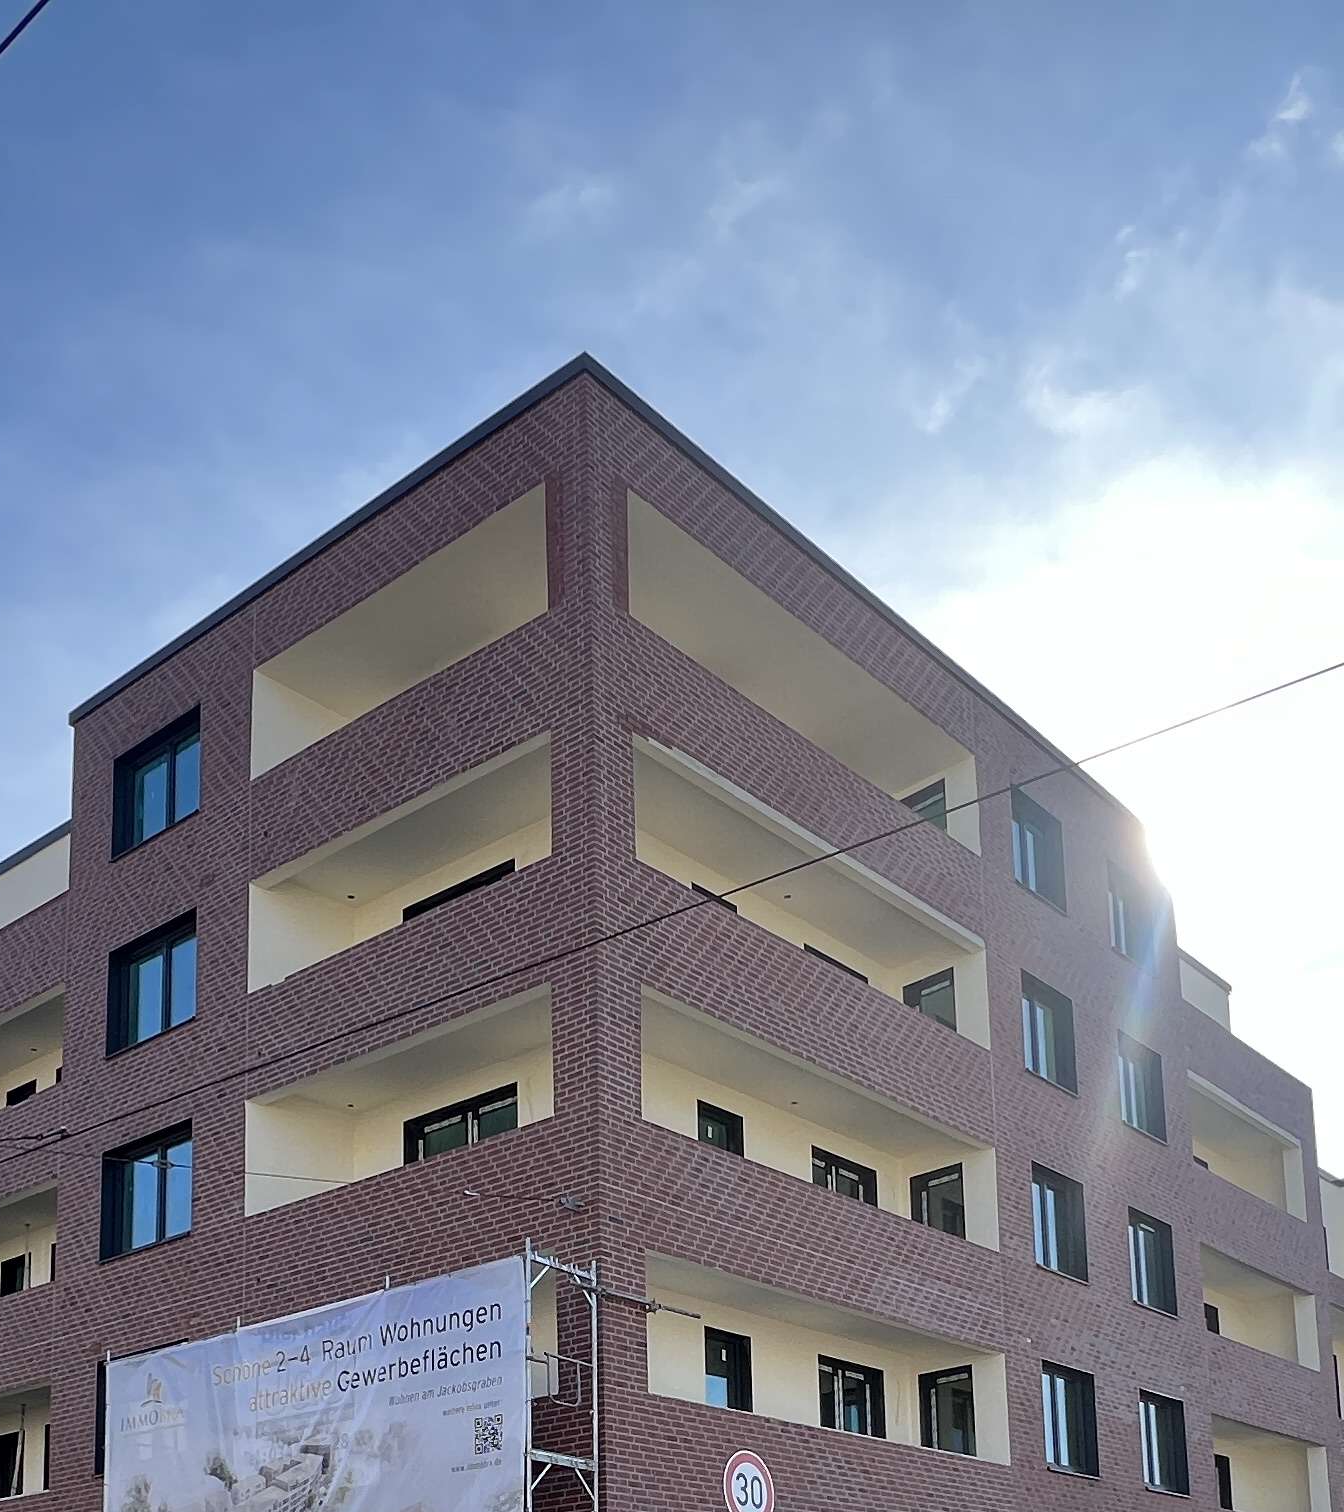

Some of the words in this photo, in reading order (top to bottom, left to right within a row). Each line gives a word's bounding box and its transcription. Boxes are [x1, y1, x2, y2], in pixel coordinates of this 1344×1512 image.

[322, 1333, 373, 1362] Raum
[380, 1303, 502, 1346] Wohnungen
[249, 1378, 332, 1412] attraktive
[337, 1340, 502, 1392] Gewerbeflächen
[735, 1473, 763, 1509] 30
